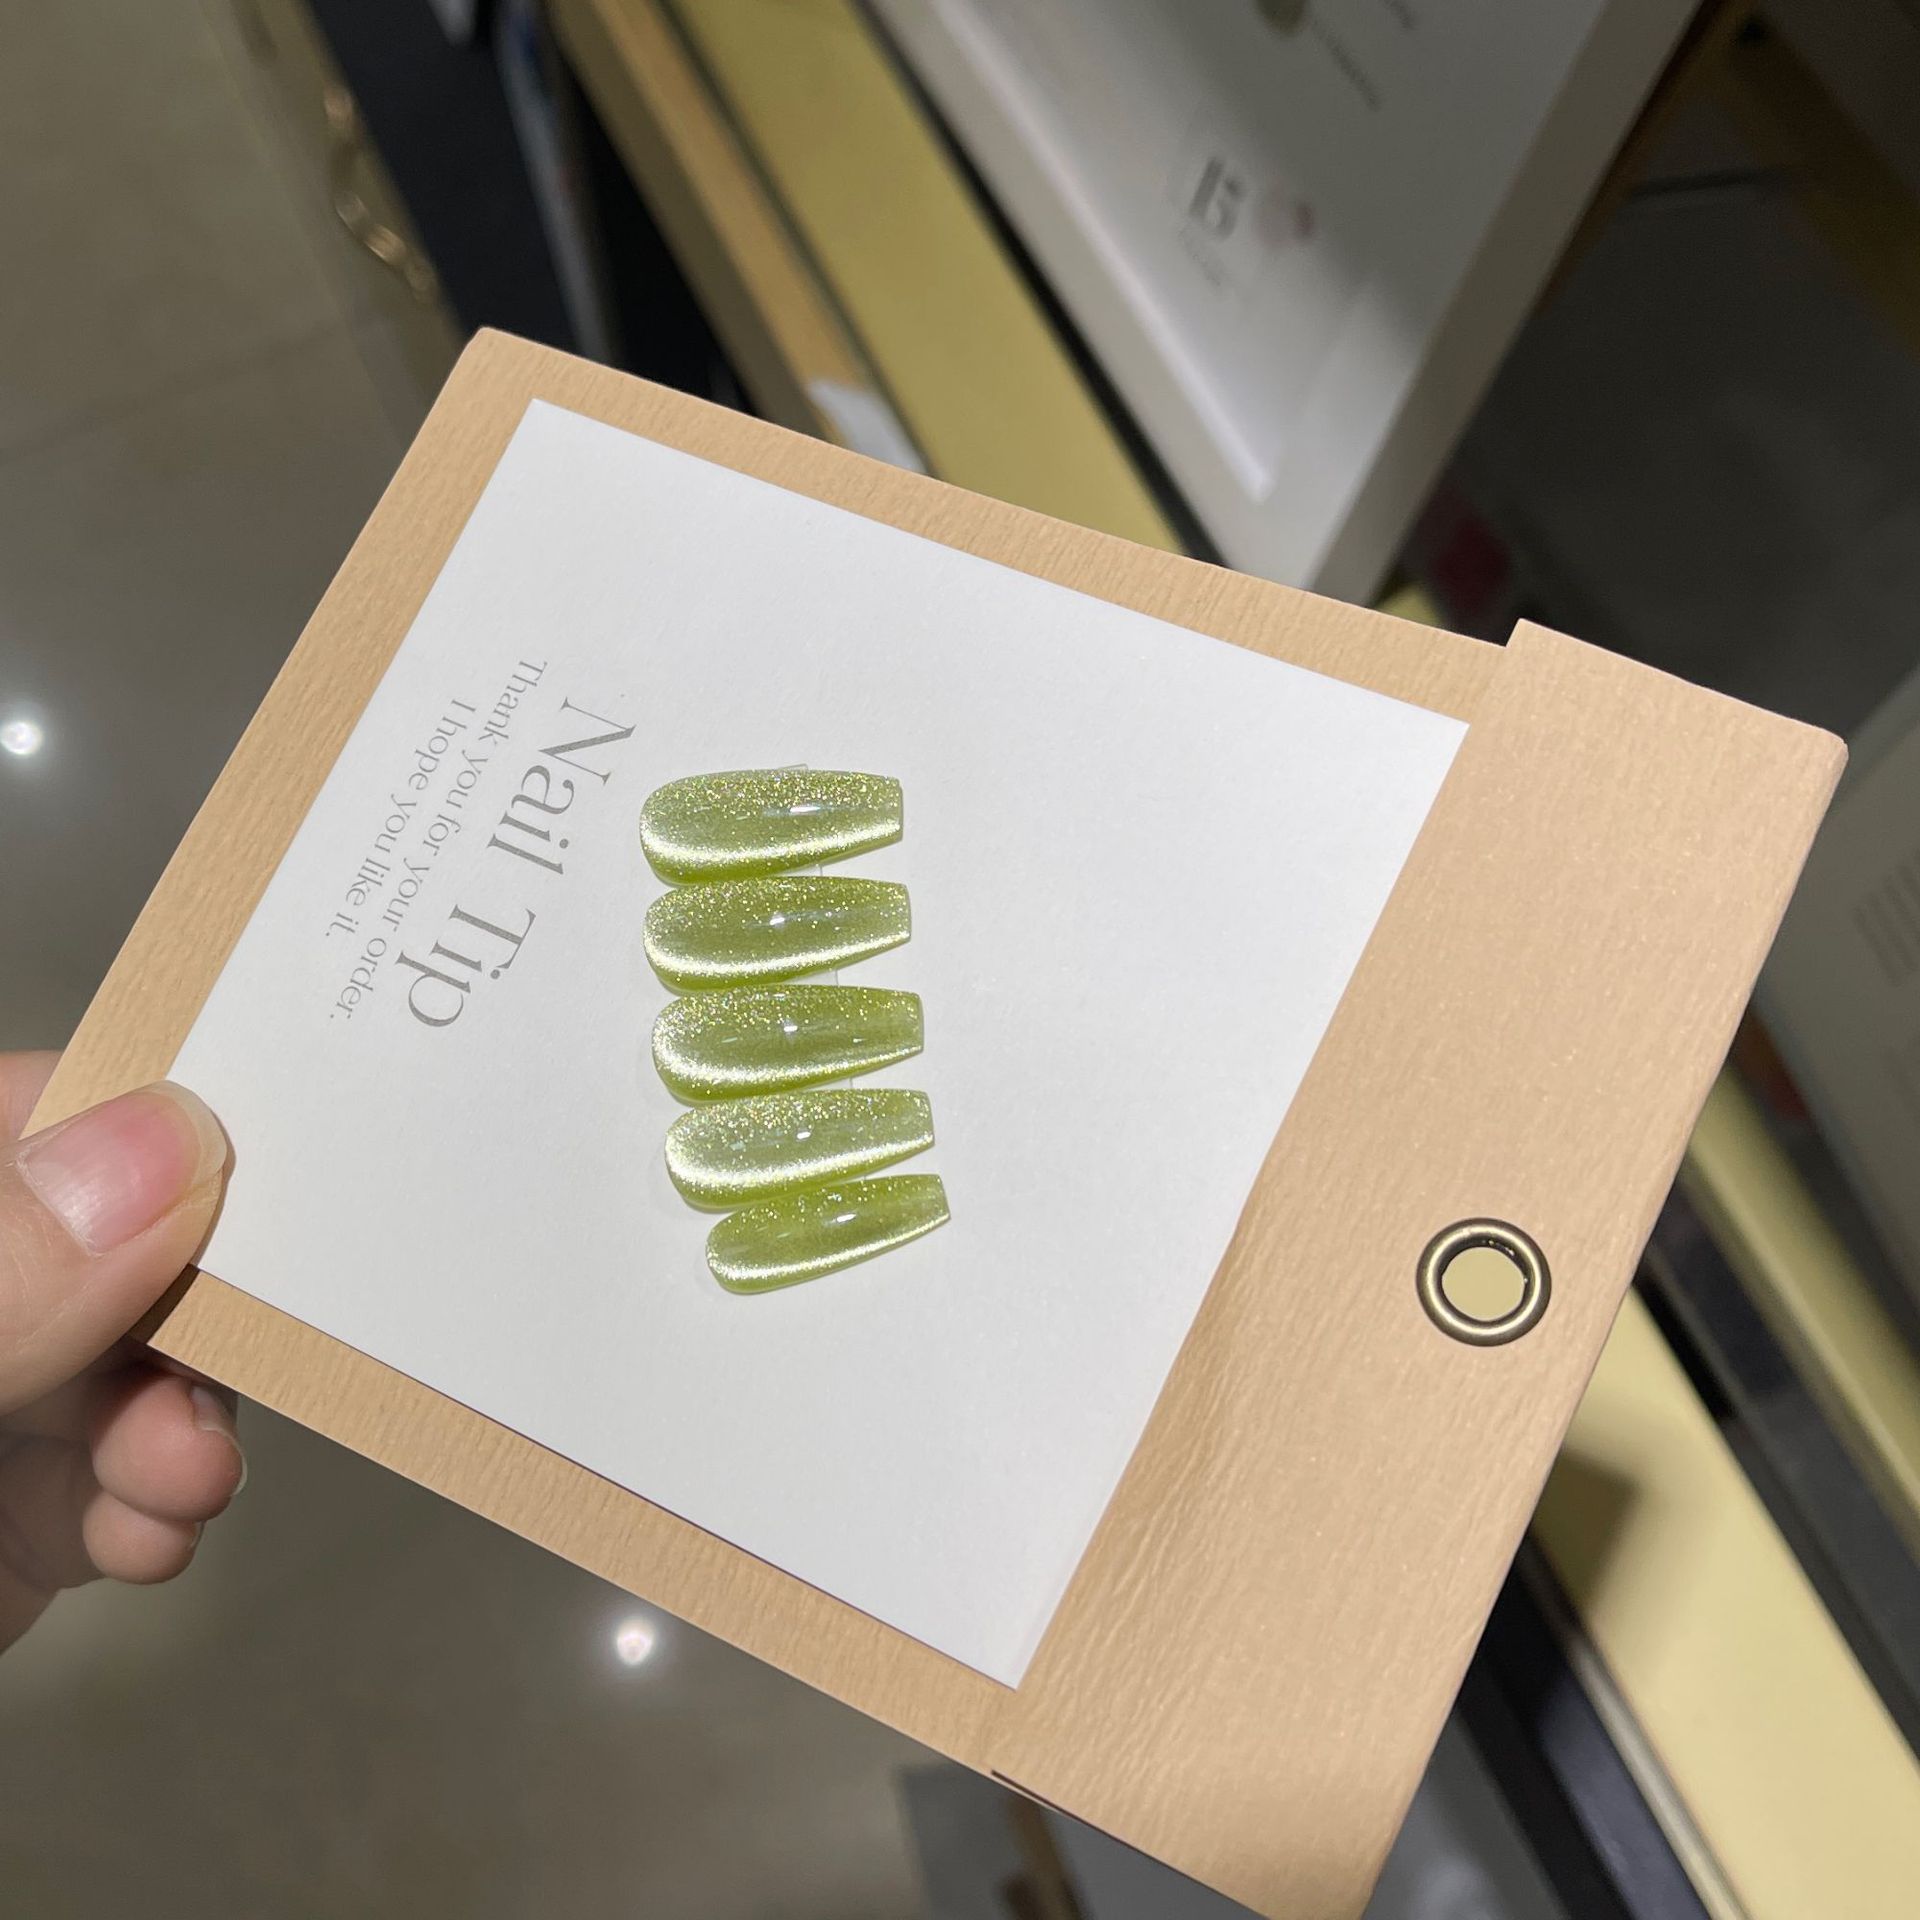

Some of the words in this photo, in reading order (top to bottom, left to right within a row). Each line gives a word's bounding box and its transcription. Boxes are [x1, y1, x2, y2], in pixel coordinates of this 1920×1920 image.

[451, 698, 477, 712] I
[478, 661, 548, 746] Thank
[408, 717, 467, 791] hope
[446, 750, 488, 808] you
[486, 697, 637, 875] Nail
[374, 794, 416, 853] you
[423, 814, 461, 857] for
[346, 858, 390, 906] like
[382, 858, 430, 931] your
[325, 912, 360, 937] it.
[329, 937, 388, 1020] order.
[395, 905, 536, 1027] Tip
